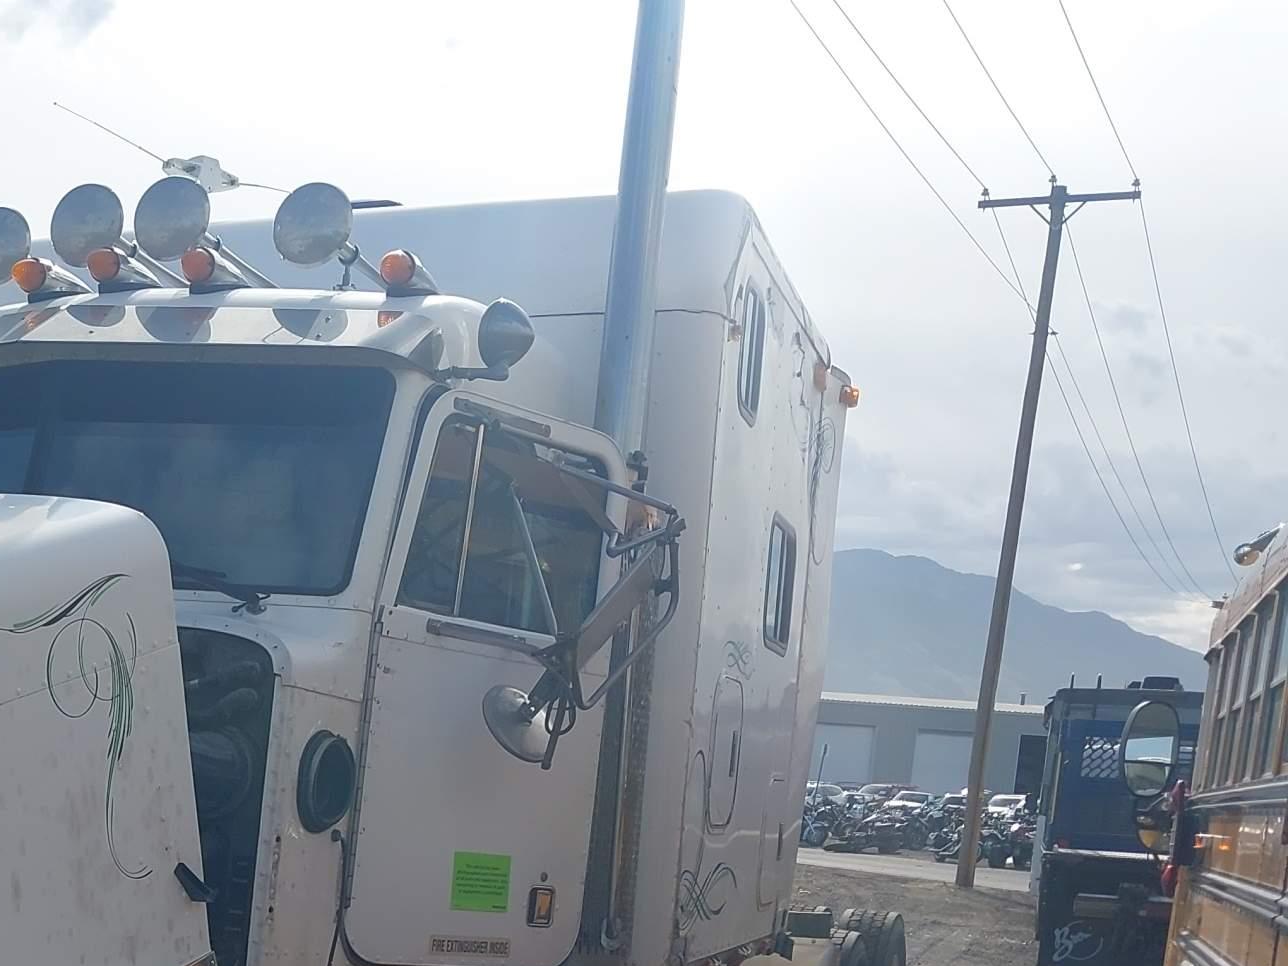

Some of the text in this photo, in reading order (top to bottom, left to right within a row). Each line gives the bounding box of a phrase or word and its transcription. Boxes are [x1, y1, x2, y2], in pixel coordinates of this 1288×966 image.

[431, 939, 509, 955] FIRE EXTINGUISHER INSIDE
